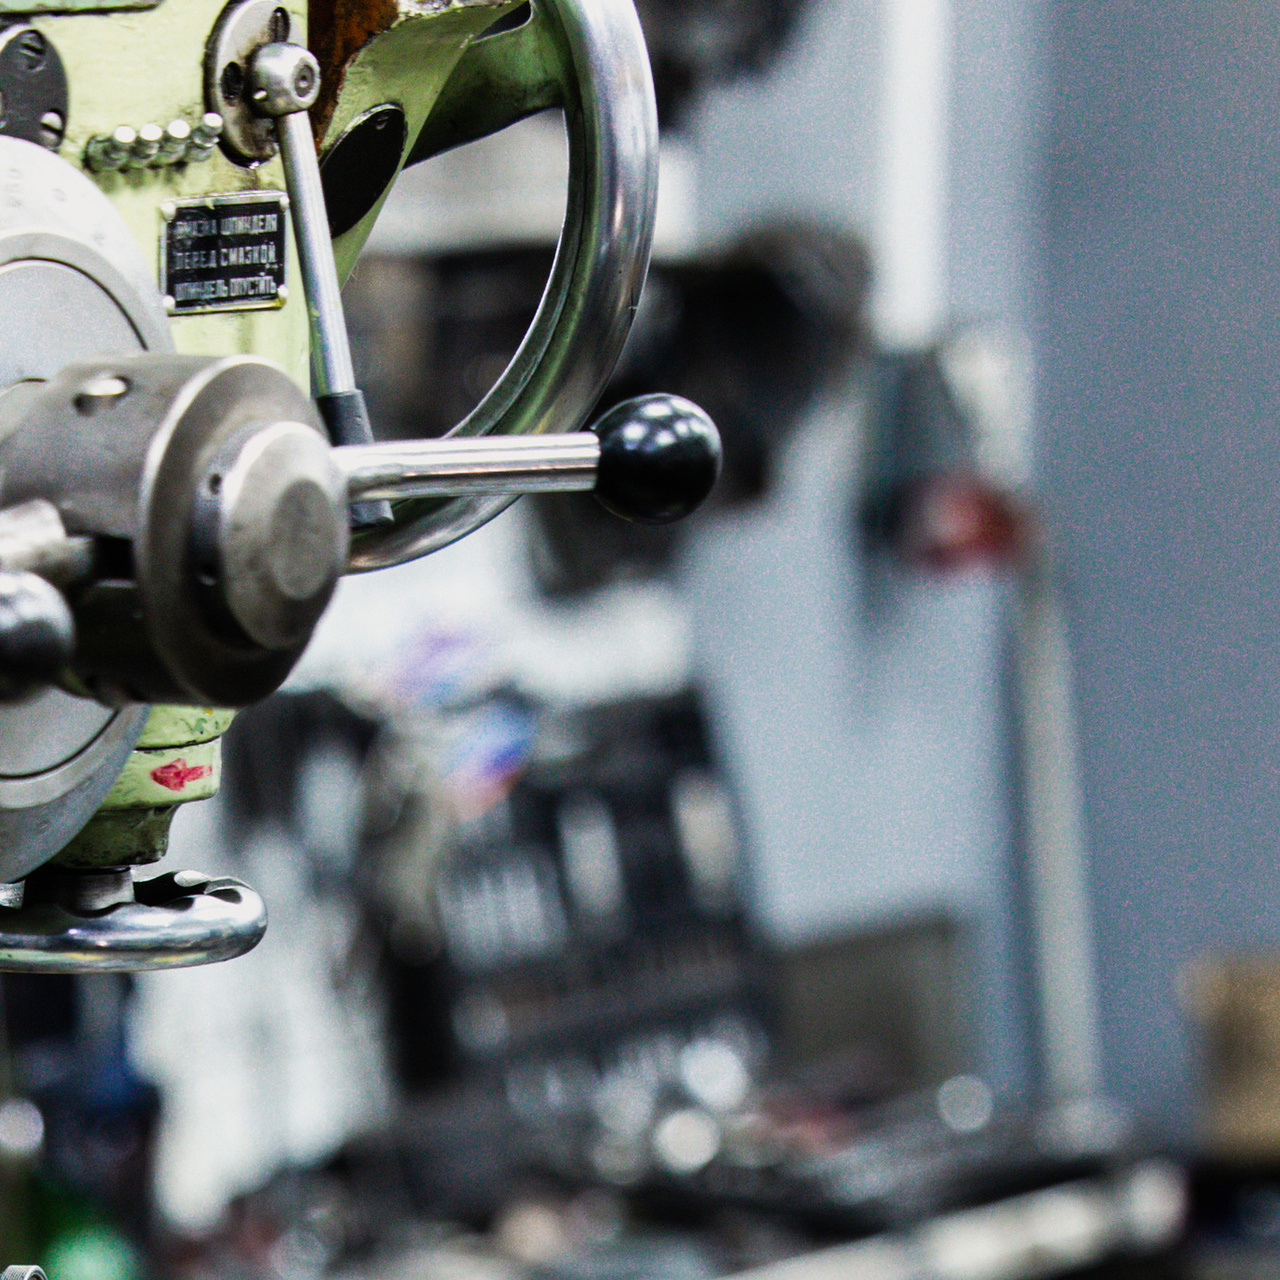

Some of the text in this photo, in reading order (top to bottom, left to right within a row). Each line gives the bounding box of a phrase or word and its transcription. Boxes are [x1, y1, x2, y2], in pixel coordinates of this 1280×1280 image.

[221, 213, 277, 235] ШПИНДЕЛЯ
[175, 249, 217, 269] ПЕРЕД
[229, 275, 277, 296] ОПУСТИТЬ
